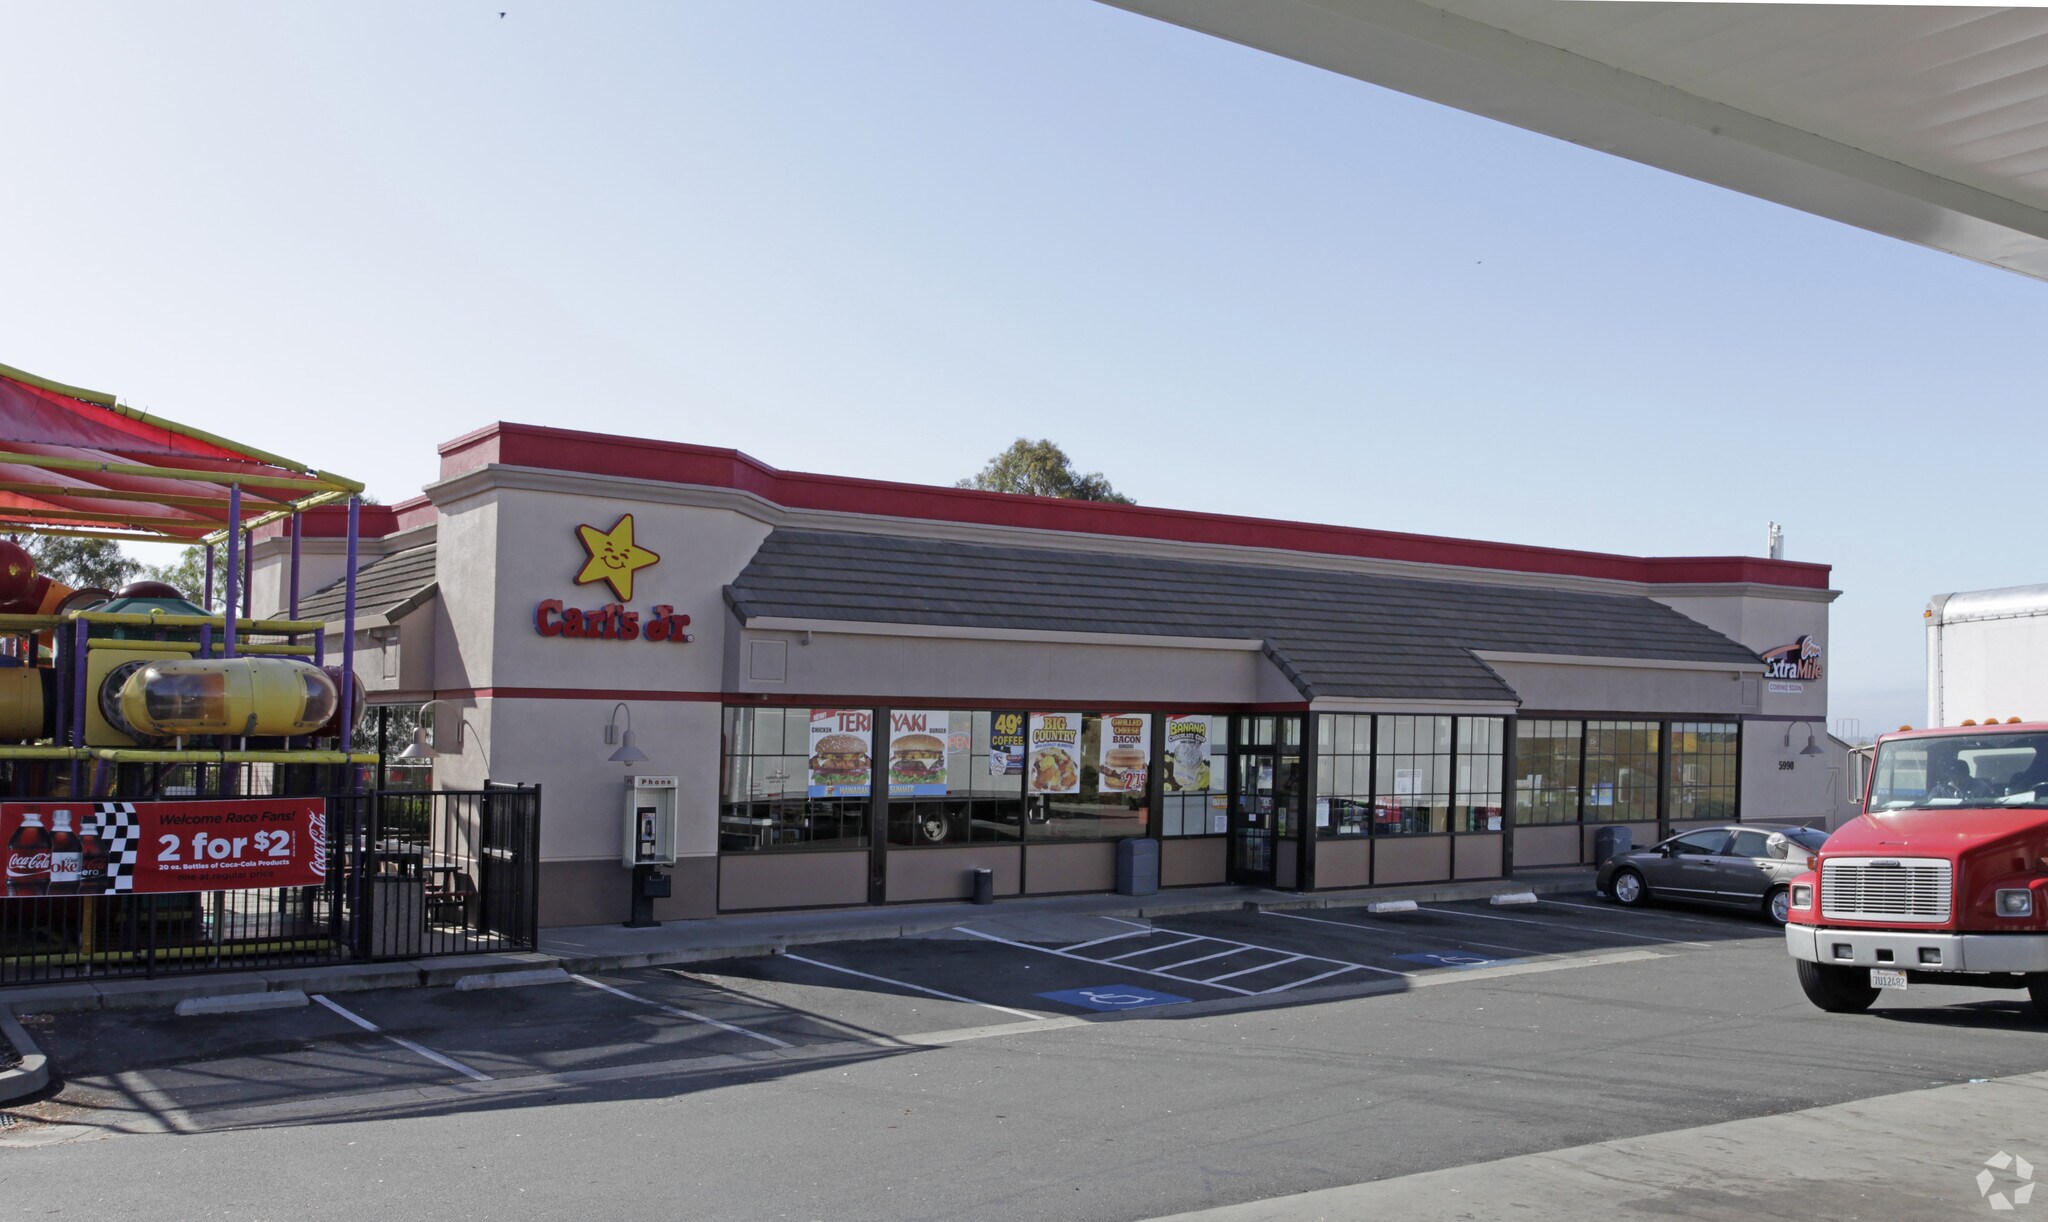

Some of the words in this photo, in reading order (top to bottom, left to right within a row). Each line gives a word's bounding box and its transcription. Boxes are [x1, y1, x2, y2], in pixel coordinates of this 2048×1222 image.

[533, 599, 639, 640] Carl's
[837, 712, 871, 732] TERI
[891, 713, 927, 732] YAKI
[1043, 716, 1067, 730] BIG
[1112, 718, 1143, 727] GRILLED
[1170, 721, 1206, 736] BANANA
[1033, 730, 1076, 744] COUNTRY
[1114, 727, 1140, 735] CHEESE
[948, 736, 972, 751] PEN
[992, 736, 1024, 746] COFFEE
[160, 813, 222, 825] Welcome
[226, 812, 258, 824] Race
[261, 811, 296, 822] Fans!
[157, 833, 181, 862] 2
[192, 832, 248, 860] for
[253, 830, 290, 857] $2
[9, 853, 51, 869] Coca-Cola
[51, 860, 78, 873] oke
[210, 861, 219, 869] of
[220, 860, 256, 868] Coca-Cola
[258, 859, 290, 867] Products
[212, 872, 247, 881] regular
[250, 870, 274, 879] price
